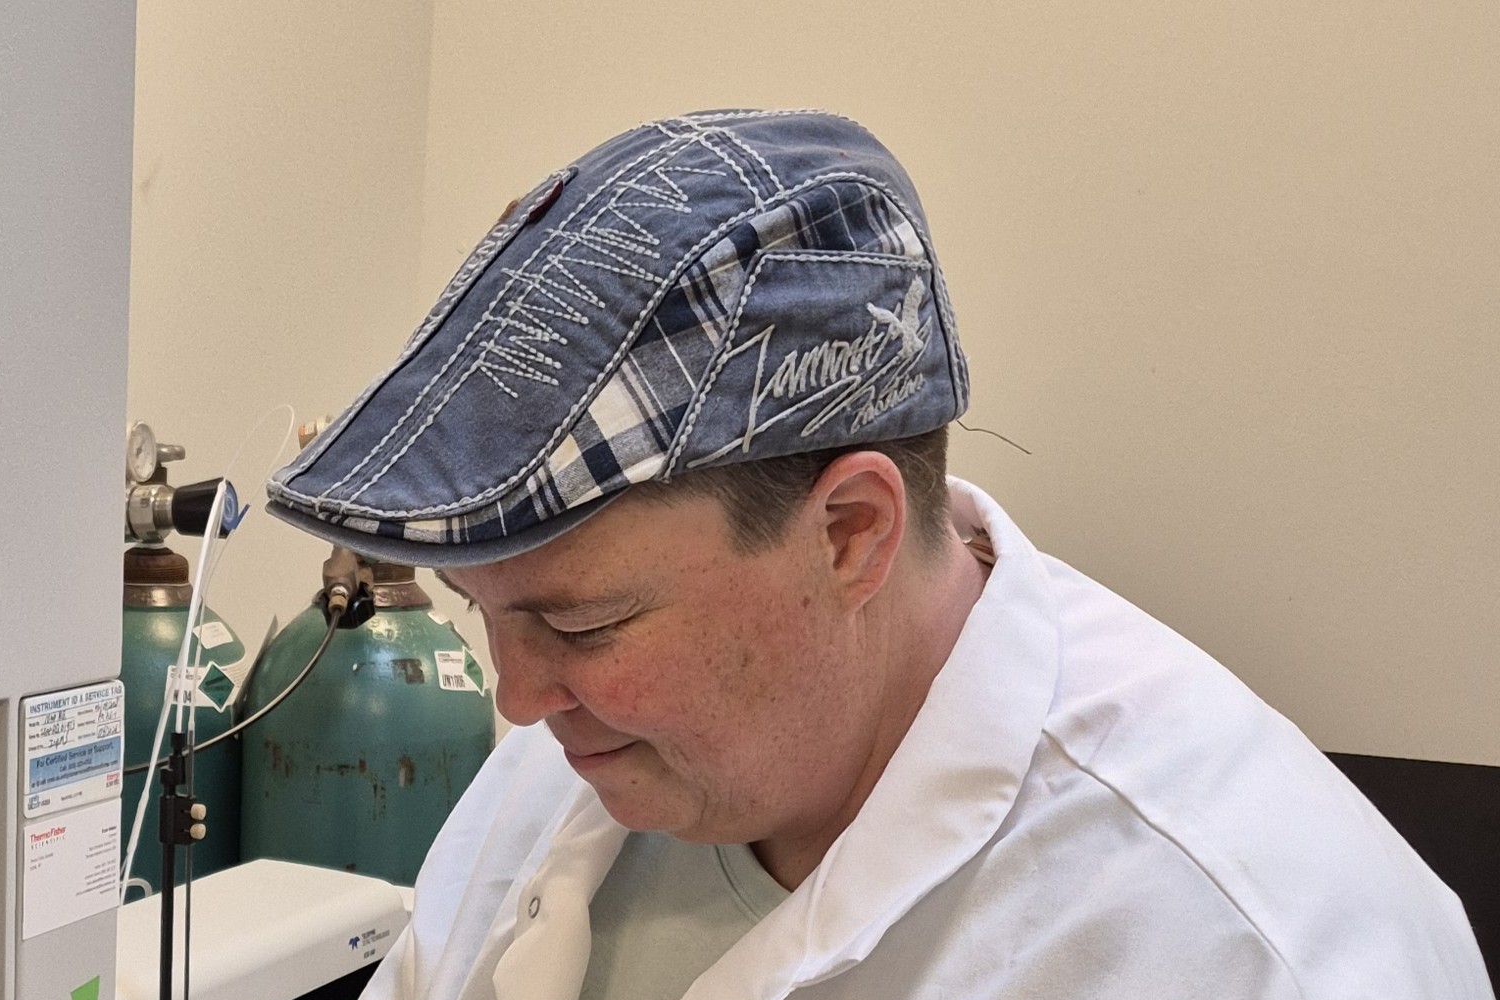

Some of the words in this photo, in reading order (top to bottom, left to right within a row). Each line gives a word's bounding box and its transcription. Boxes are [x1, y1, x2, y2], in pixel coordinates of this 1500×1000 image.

[29, 697, 71, 714] INSTRUMENT
[71, 695, 78, 705] ID
[84, 688, 110, 702] SERVICE
[36, 758, 45, 768] For
[45, 753, 68, 767] Certified
[69, 749, 86, 761] Service
[31, 836, 66, 850] SCIENTIFIC
